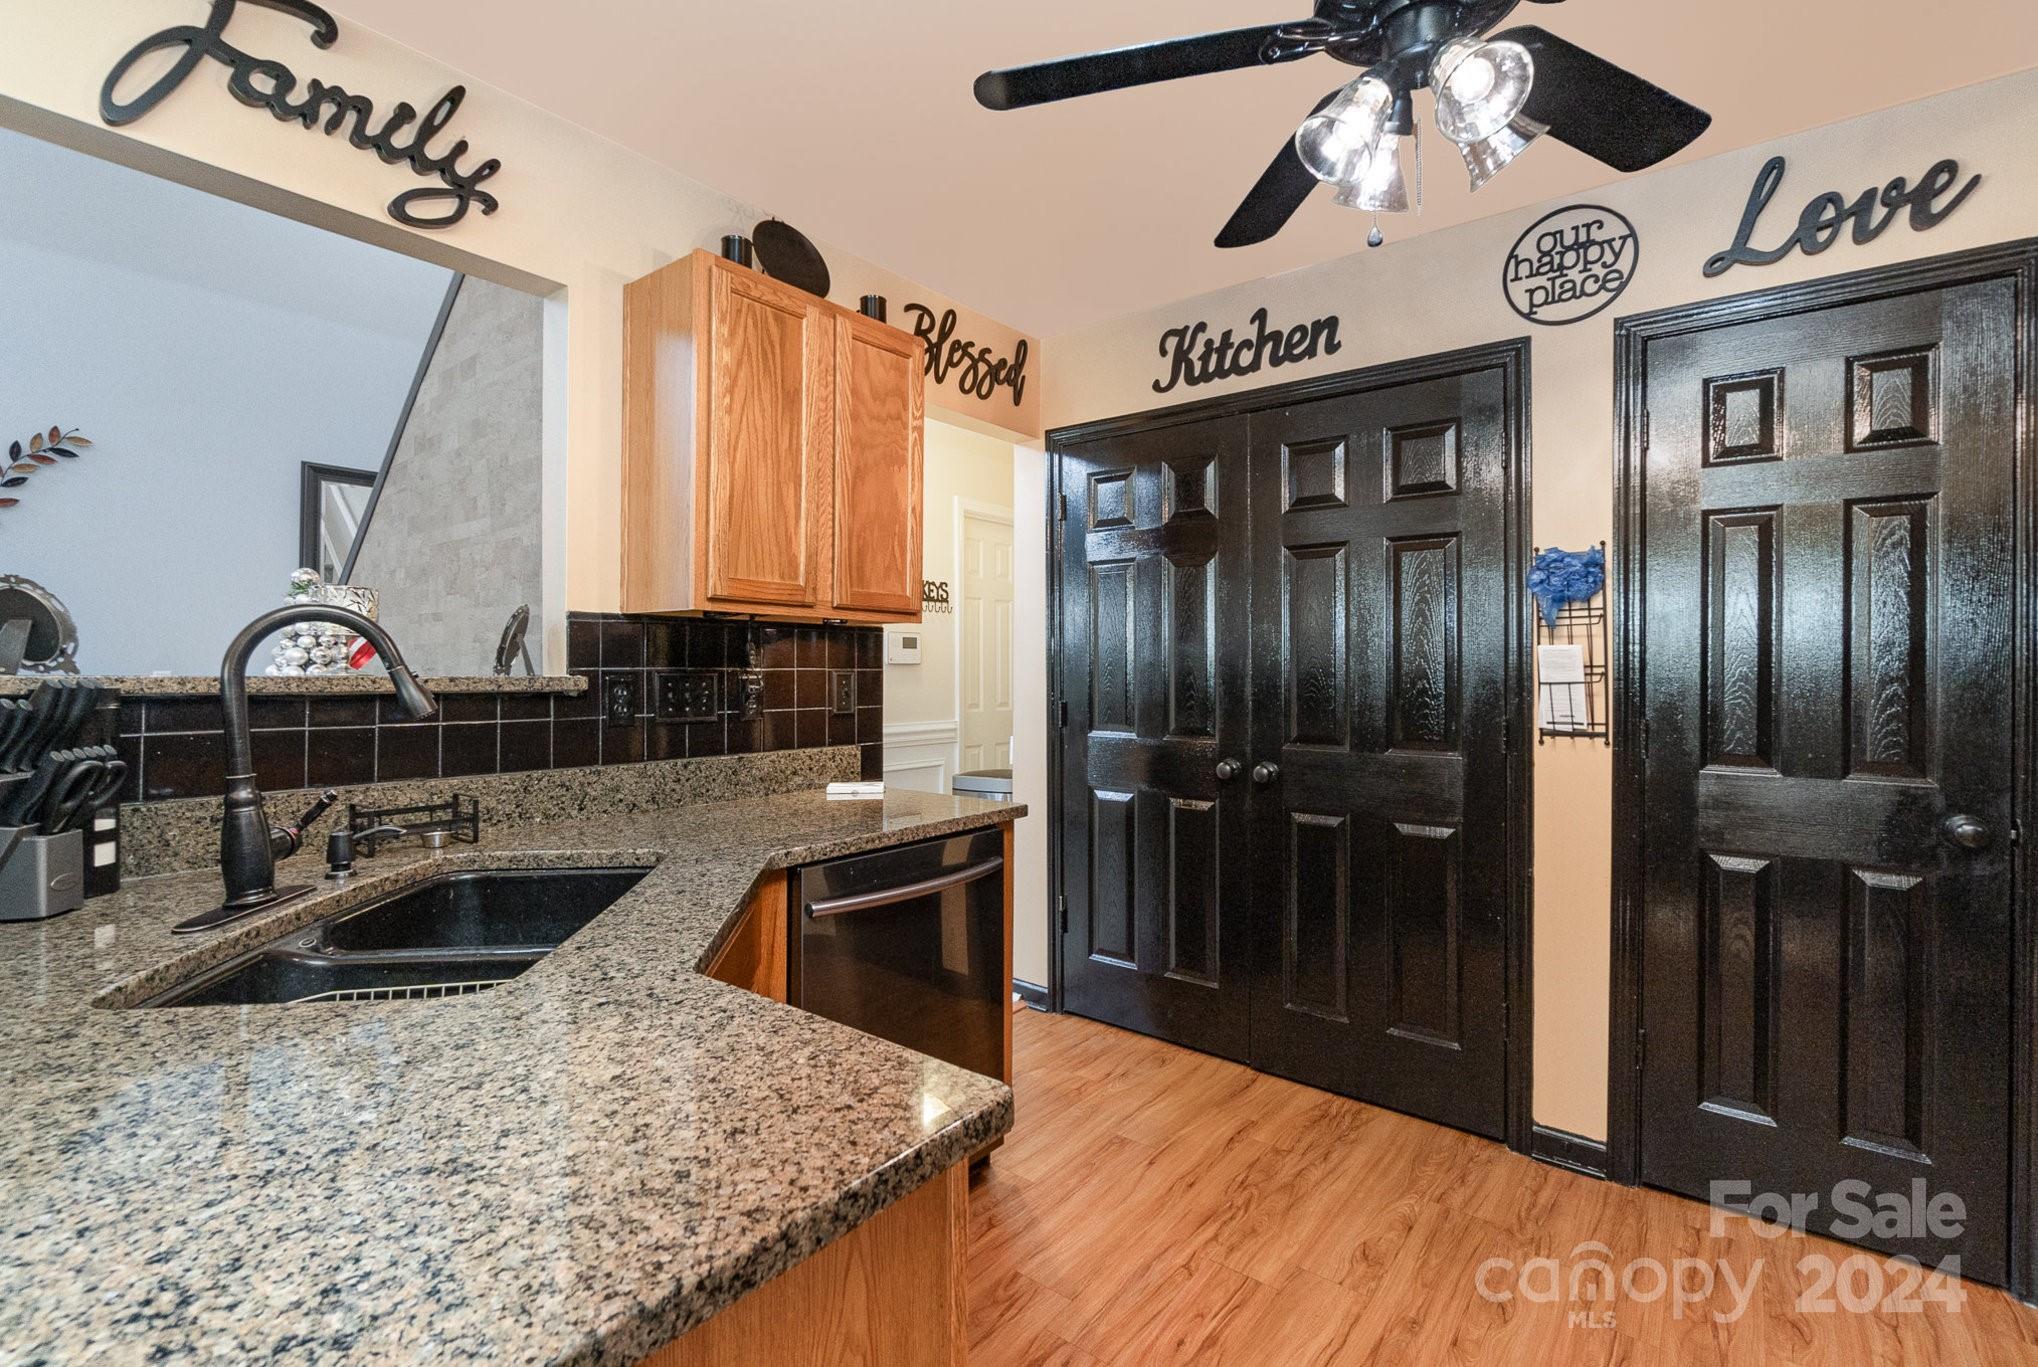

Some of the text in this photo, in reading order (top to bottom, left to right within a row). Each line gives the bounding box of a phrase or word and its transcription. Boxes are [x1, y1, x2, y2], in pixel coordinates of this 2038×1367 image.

[98, 0, 502, 229] Family
[1509, 233, 1633, 283] happy
[1536, 219, 1604, 253] our
[1703, 156, 1982, 278] Love
[1524, 268, 1625, 318] place
[904, 303, 1028, 407] Blessed
[1152, 307, 1342, 393] Kitchen
